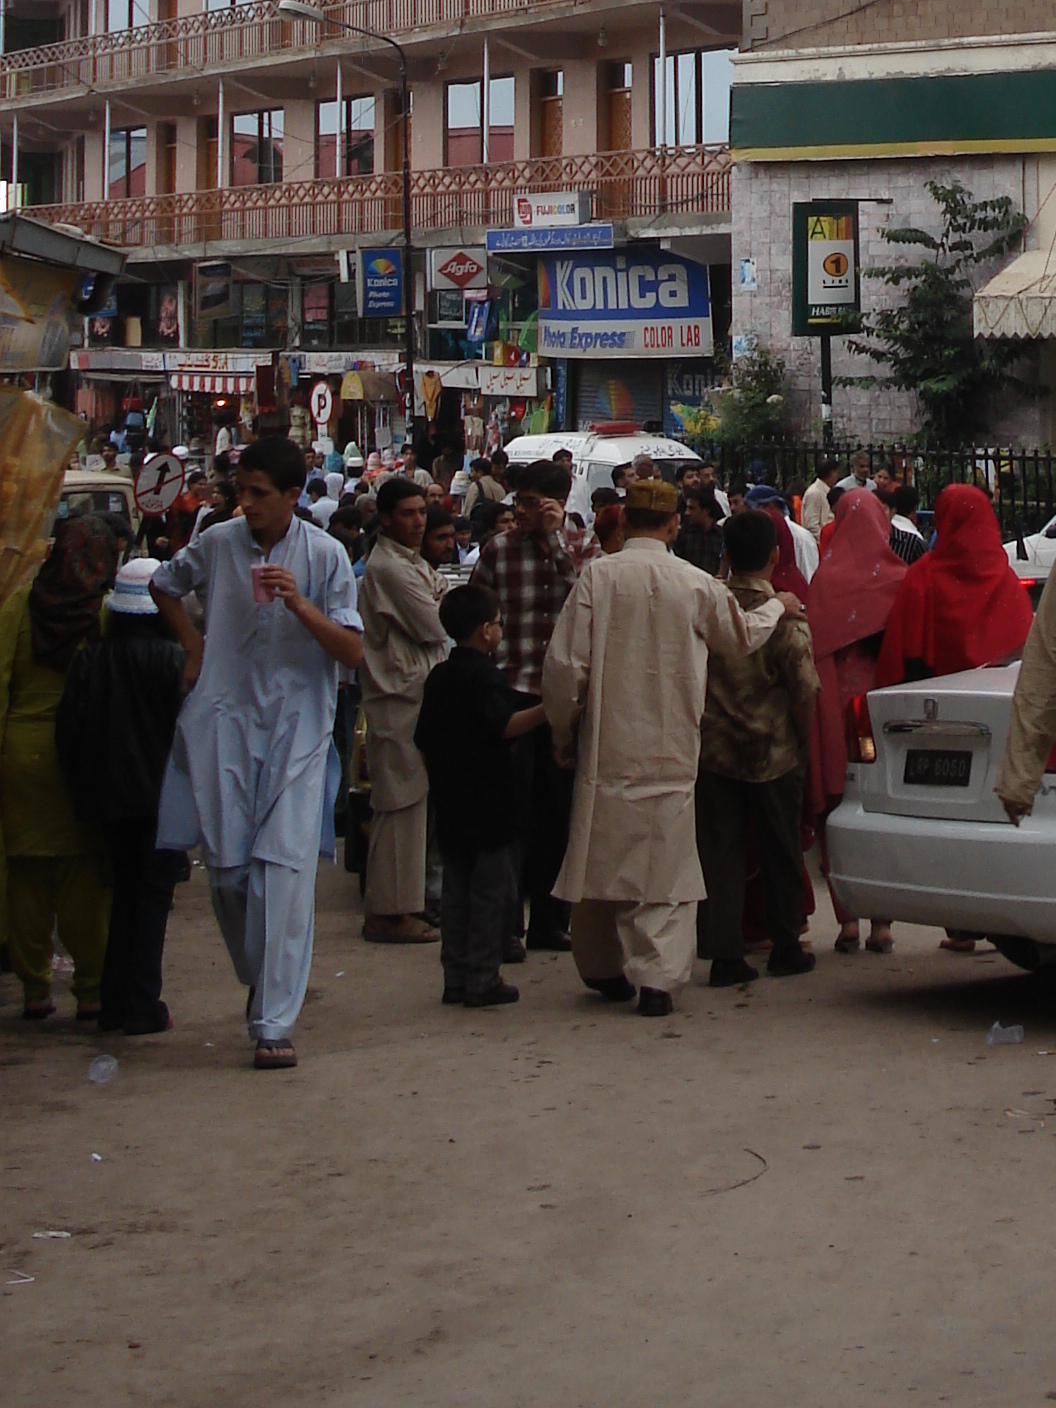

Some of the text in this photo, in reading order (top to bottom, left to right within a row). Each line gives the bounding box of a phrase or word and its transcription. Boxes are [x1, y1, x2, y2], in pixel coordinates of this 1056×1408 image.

[536, 203, 575, 216] FUJICOLOR
[442, 261, 478, 276] Agfa
[366, 277, 398, 288] Konica
[556, 255, 690, 311] Konica
[367, 301, 395, 309] Express
[569, 326, 626, 352] Express
[643, 326, 674, 349] COLOR
[680, 325, 701, 348] LAB
